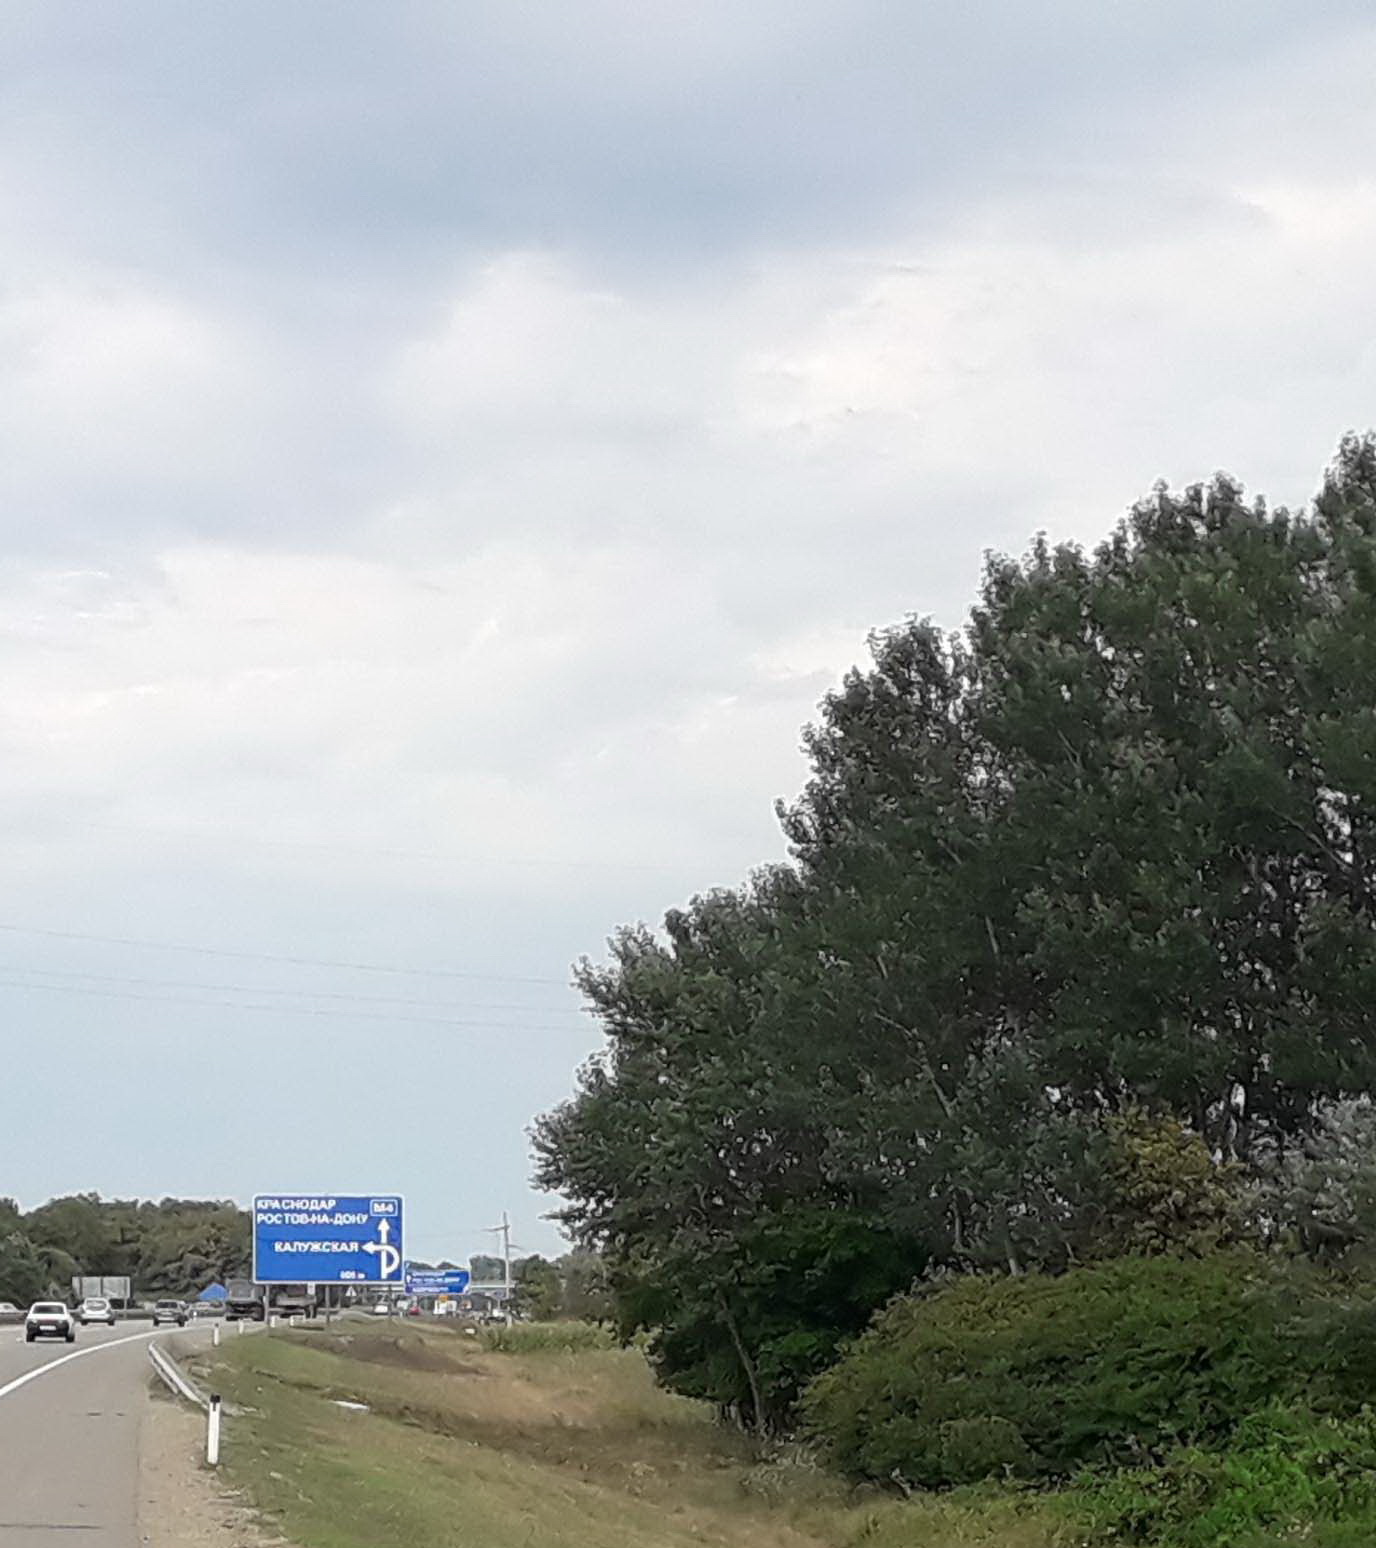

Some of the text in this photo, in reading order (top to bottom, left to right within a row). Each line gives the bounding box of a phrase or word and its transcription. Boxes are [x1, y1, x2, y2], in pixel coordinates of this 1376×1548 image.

[256, 1199, 337, 1211] КРАСНОДАР
[256, 1213, 369, 1226] РОСТОВ-НА-ДОНУ
[274, 1241, 360, 1253] КАЛУЖСКАЯ
